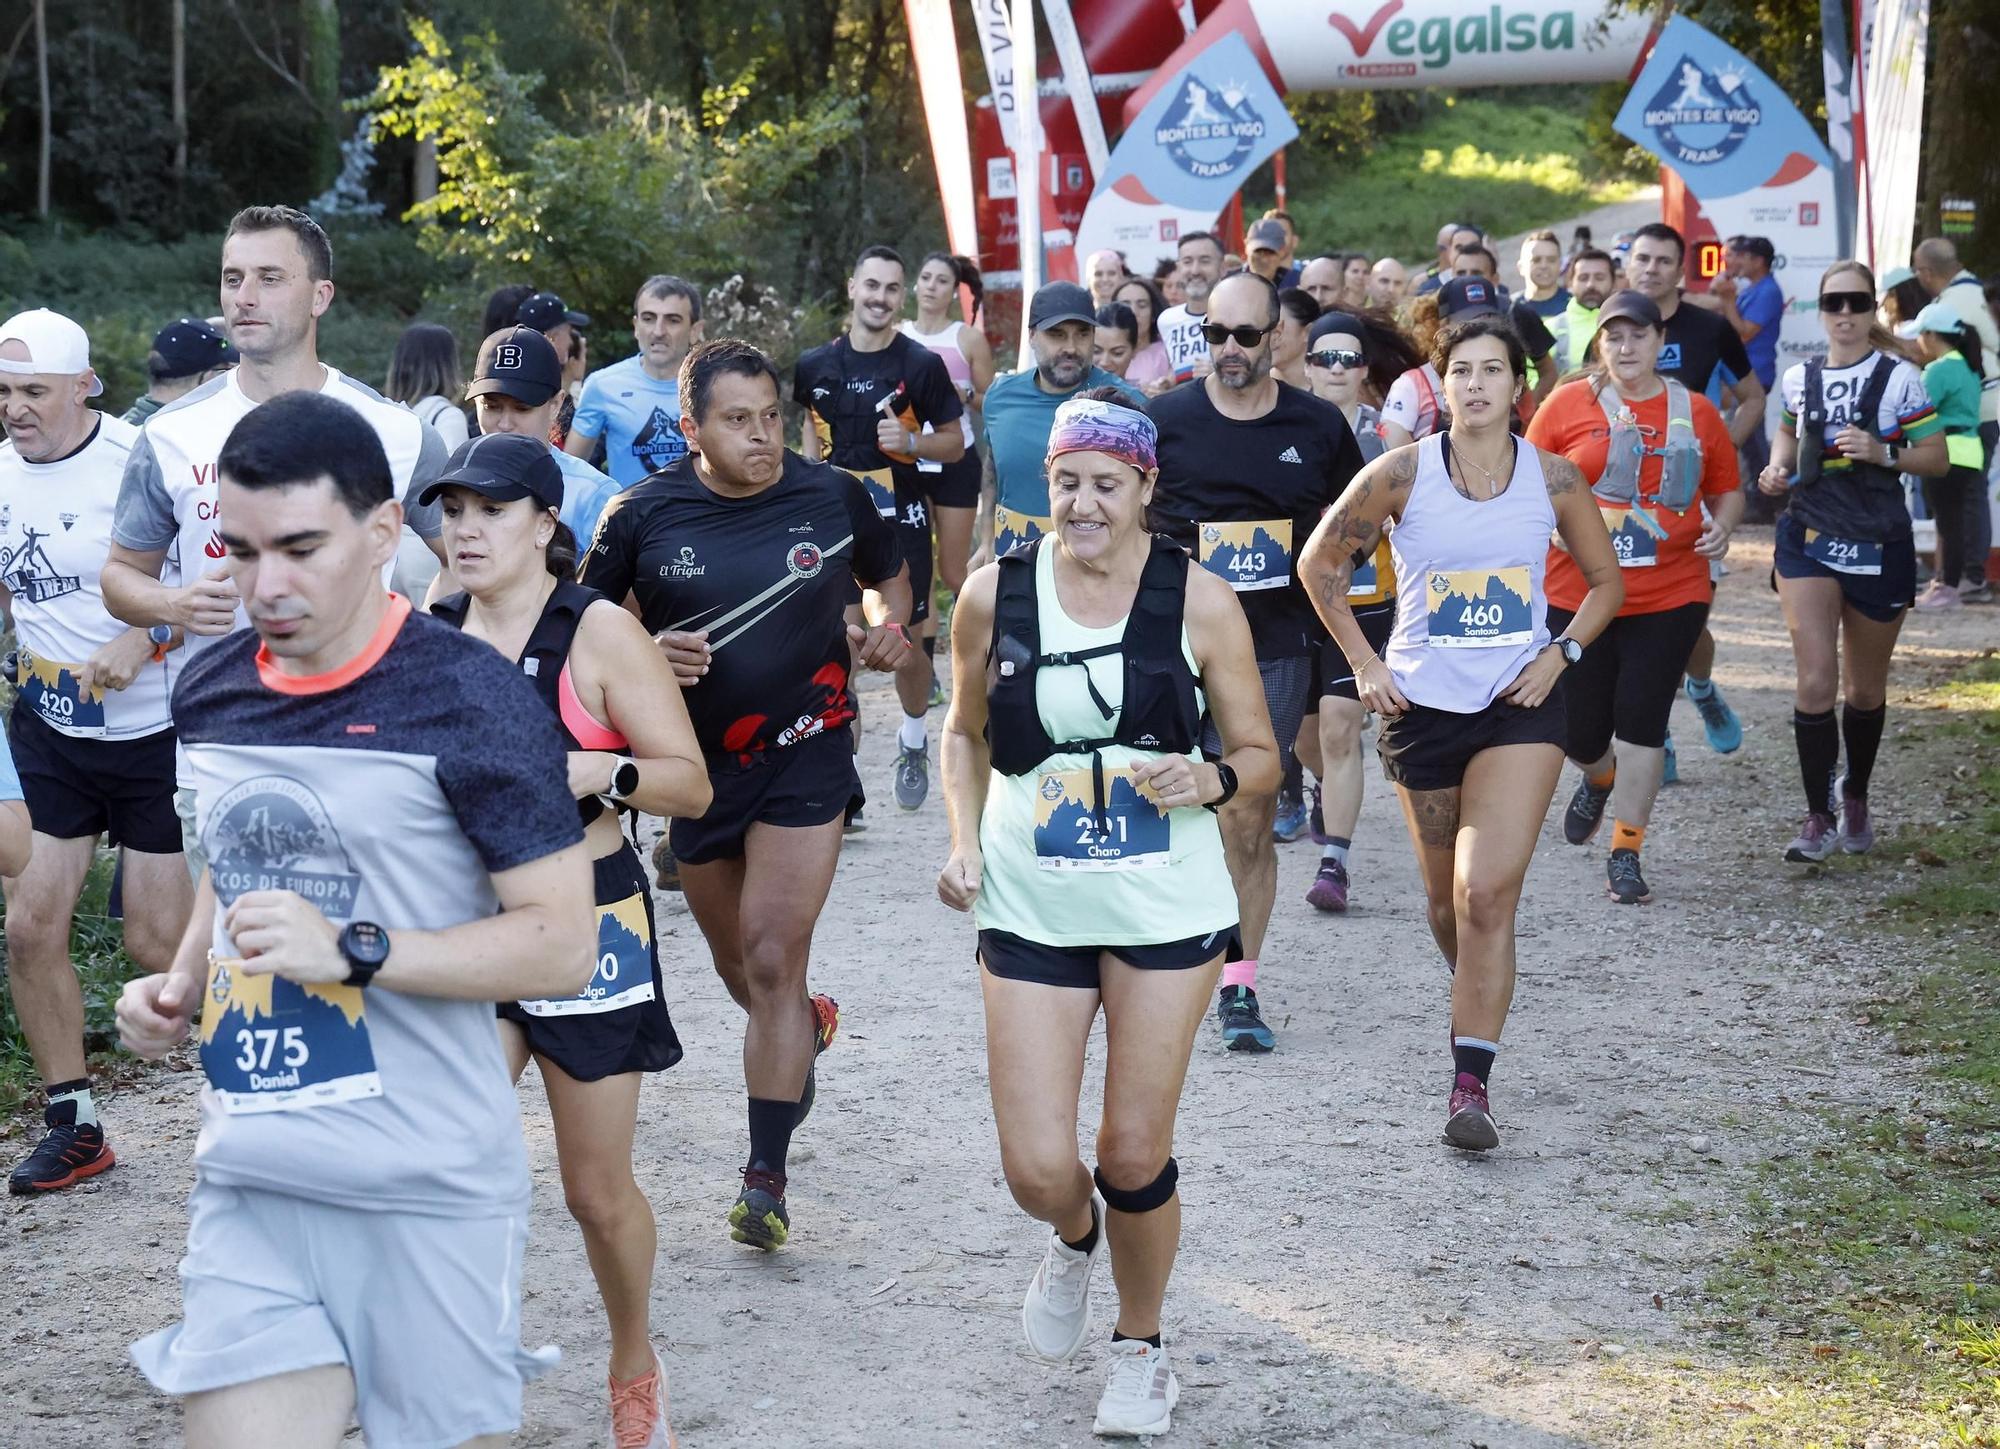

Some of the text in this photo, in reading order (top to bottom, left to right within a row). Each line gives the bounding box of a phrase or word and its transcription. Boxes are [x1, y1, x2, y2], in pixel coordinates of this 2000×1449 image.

[1329, 0, 1574, 68] Vegalsa
[1645, 108, 1760, 126] MONTES DE VIGO
[1157, 121, 1263, 143] MONTES DE VIGO
[1679, 147, 1724, 162] TRAIL
[1192, 161, 1234, 176] TRAIL
[495, 345, 522, 369] B
[633, 443, 684, 455] MONTES DE
[1279, 455, 1302, 464] adidas
[1827, 541, 1859, 559] 224
[1228, 552, 1266, 572] 443
[659, 564, 706, 579] El Trigal
[1239, 572, 1257, 581] Dani
[1459, 604, 1503, 627] 460
[1464, 627, 1500, 637] Santoxo
[40, 690, 74, 717] 420
[788, 729, 824, 746] APTONIA
[1087, 845, 1121, 857] Charo
[259, 874, 281, 891] DE
[285, 877, 352, 900] EUROPA
[235, 1026, 310, 1072] 375
[250, 1067, 300, 1090] Daniel
